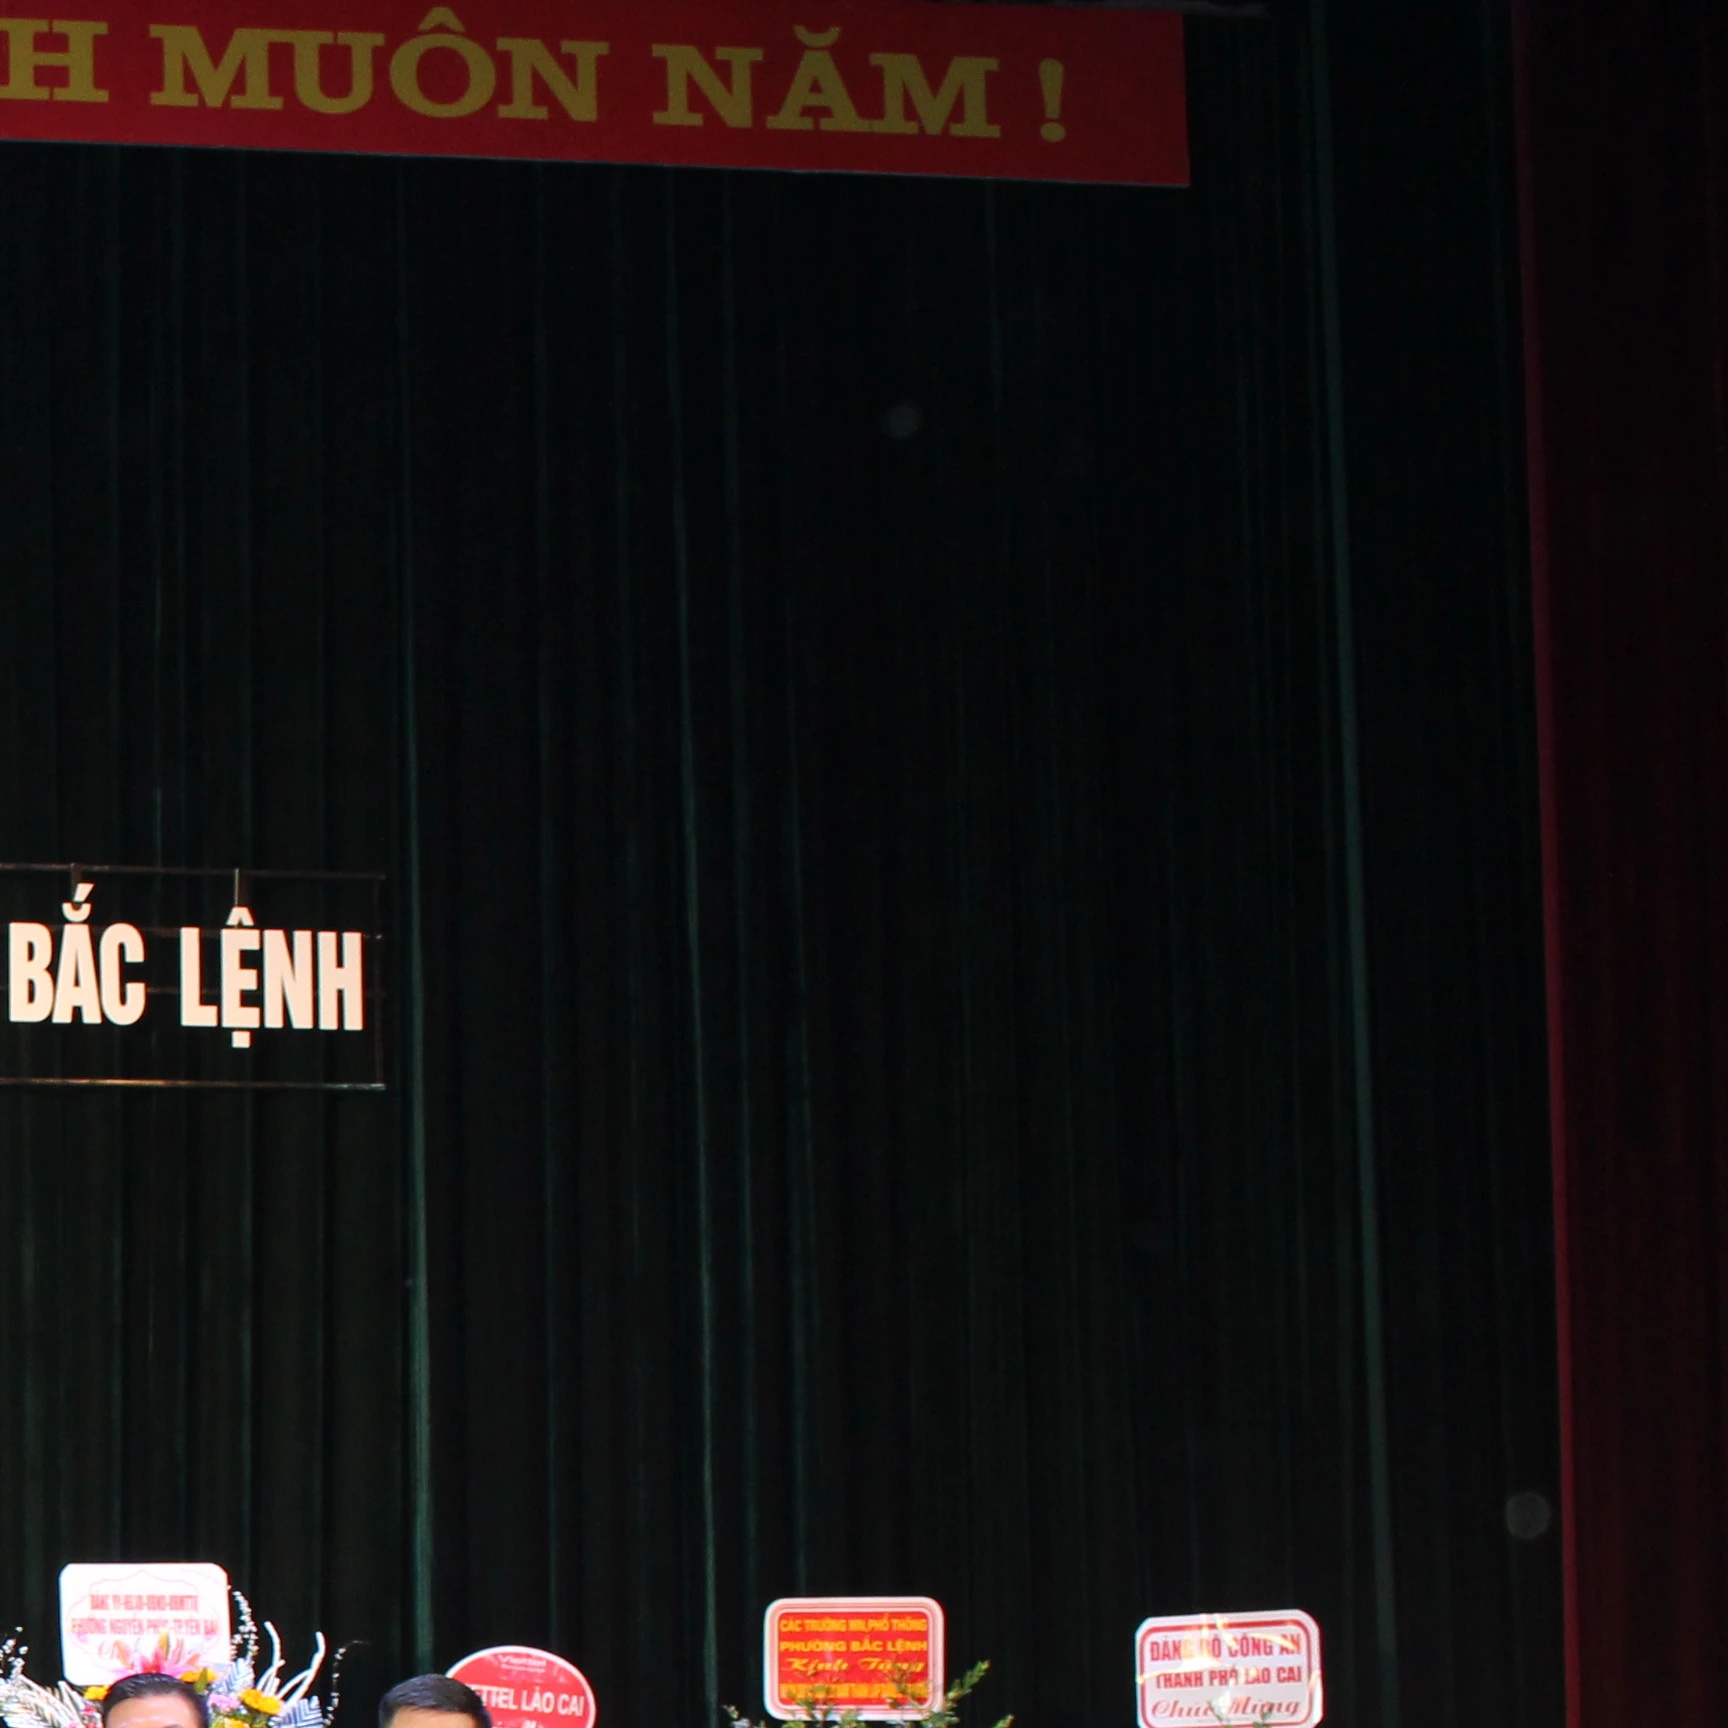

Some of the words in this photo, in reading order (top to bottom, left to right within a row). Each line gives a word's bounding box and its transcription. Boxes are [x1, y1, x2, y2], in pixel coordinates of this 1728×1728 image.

[150, 8, 608, 121] MUÔN
[653, 25, 1001, 139] NĂM
[9, 884, 144, 1025] BẮC
[180, 907, 362, 1048] LỆNH
[780, 1616, 802, 1632] CÁC
[780, 1639, 847, 1652] PHƯỜNG
[850, 1635, 884, 1652] BẮC
[887, 1638, 928, 1654] LỆNH
[1277, 1665, 1302, 1683] CAI
[521, 1686, 555, 1714] LÀO
[558, 1693, 585, 1717] CAI
